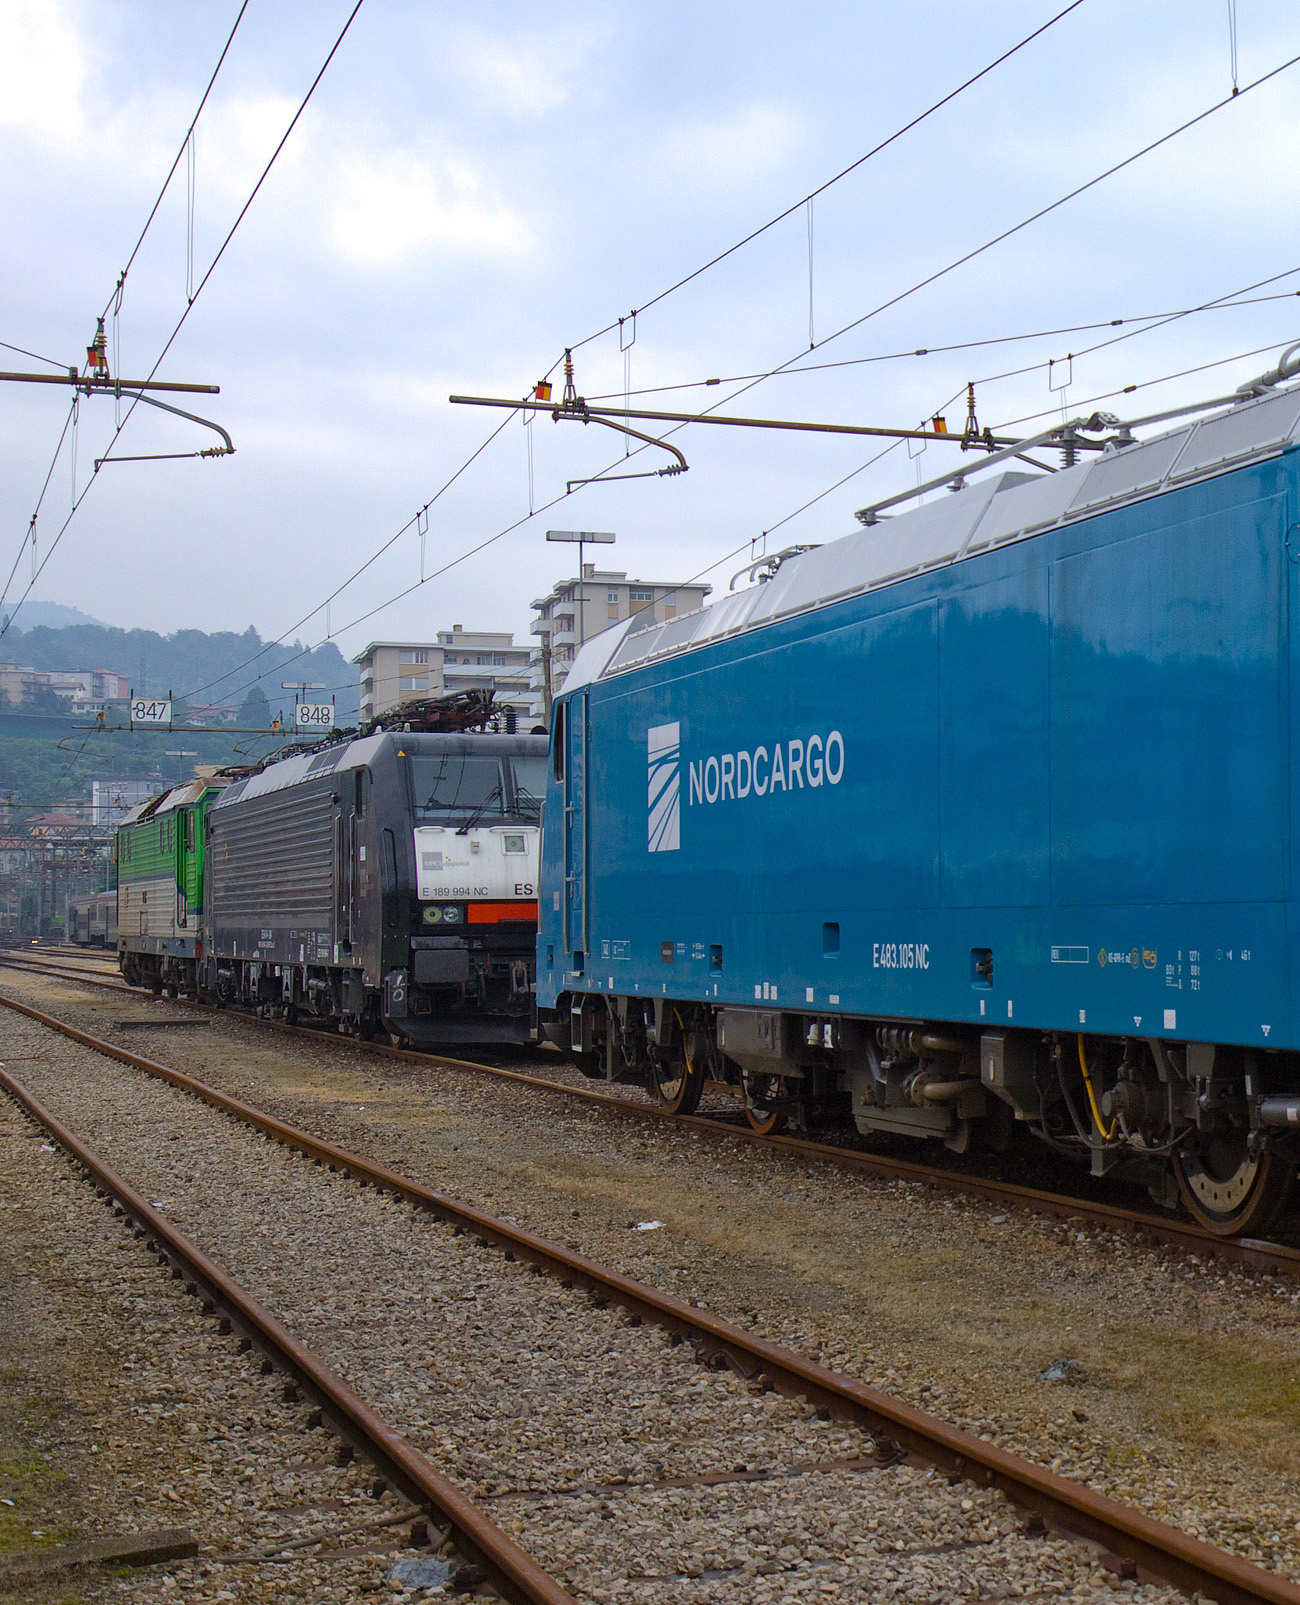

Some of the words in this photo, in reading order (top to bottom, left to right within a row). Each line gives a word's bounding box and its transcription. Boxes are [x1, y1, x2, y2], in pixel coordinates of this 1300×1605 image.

[136, 701, 168, 719] 847
[300, 706, 330, 723] 848
[689, 730, 845, 806] NORDCARGO
[423, 888, 430, 896] E
[433, 887, 450, 896] 189
[453, 887, 470, 896] 994
[474, 887, 489, 896] NC
[515, 884, 533, 895] ES
[873, 943, 880, 968] E
[880, 943, 914, 969] 483.105
[915, 943, 930, 969] NC
